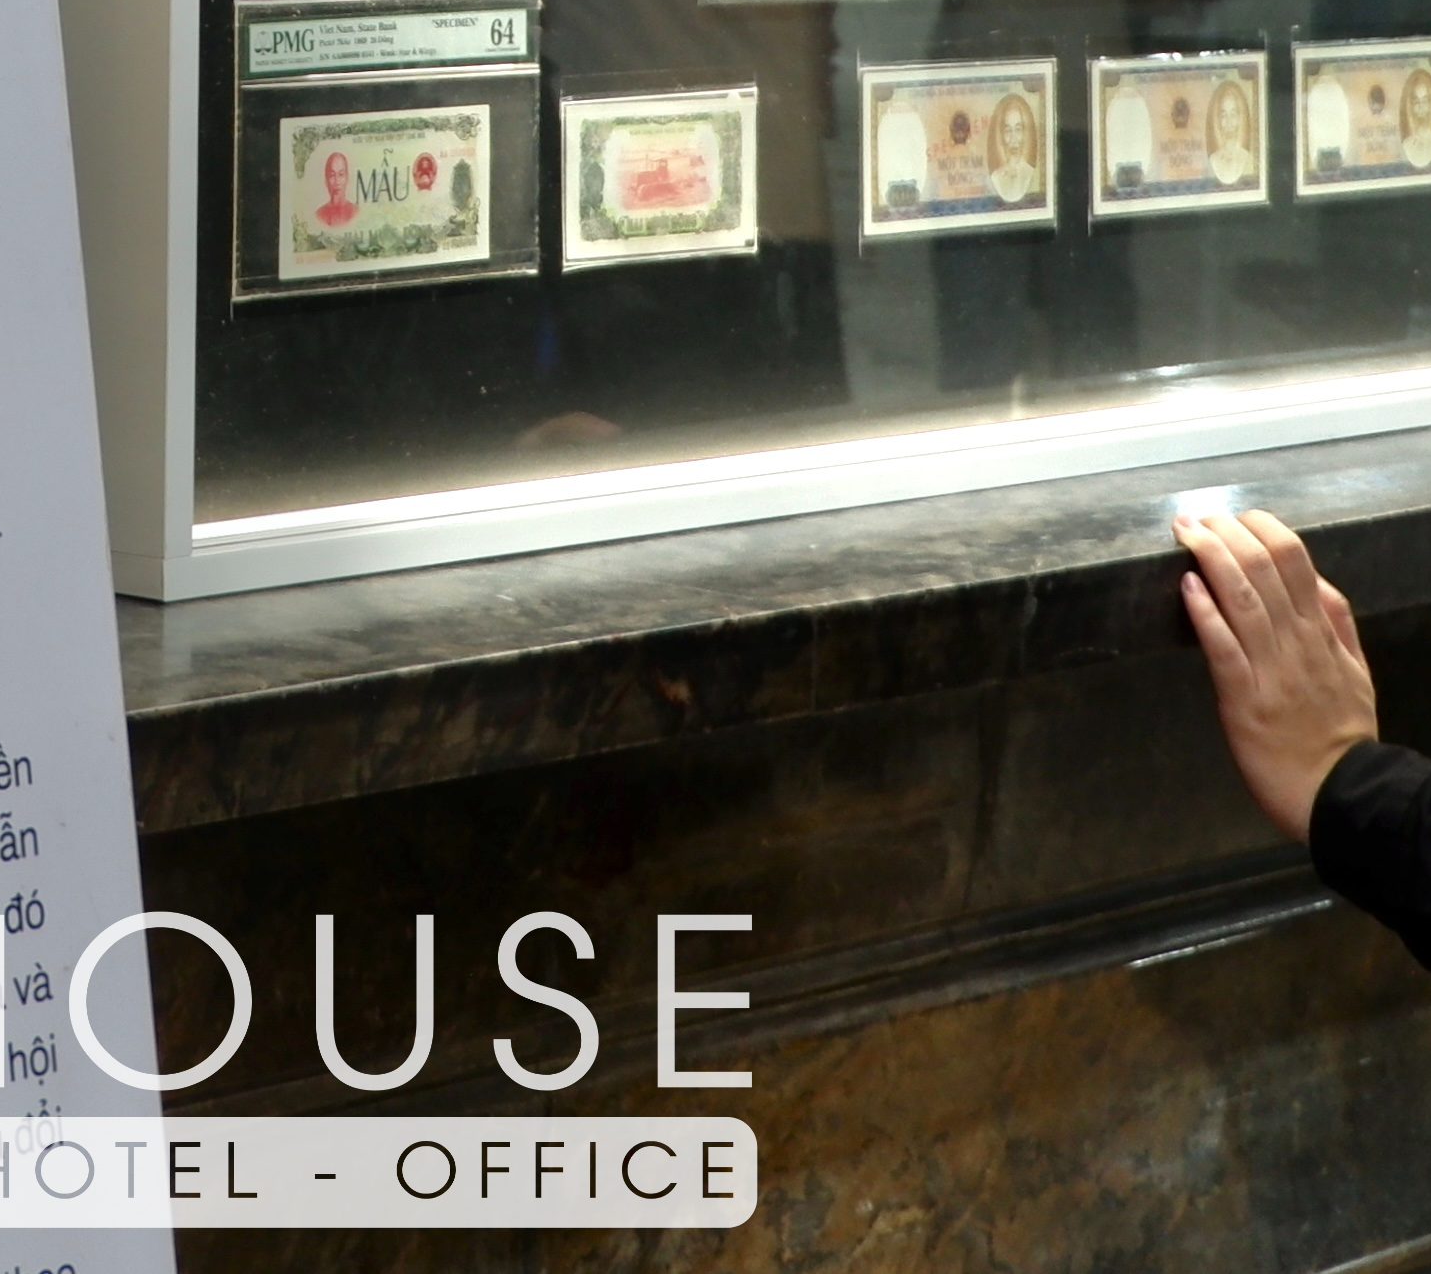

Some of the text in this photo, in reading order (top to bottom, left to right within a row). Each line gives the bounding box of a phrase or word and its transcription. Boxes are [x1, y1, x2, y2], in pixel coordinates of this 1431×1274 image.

[272, 28, 316, 55] PMG
[378, 21, 398, 32] Bank
[490, 18, 516, 46] 64
[354, 147, 411, 206] MẪU
